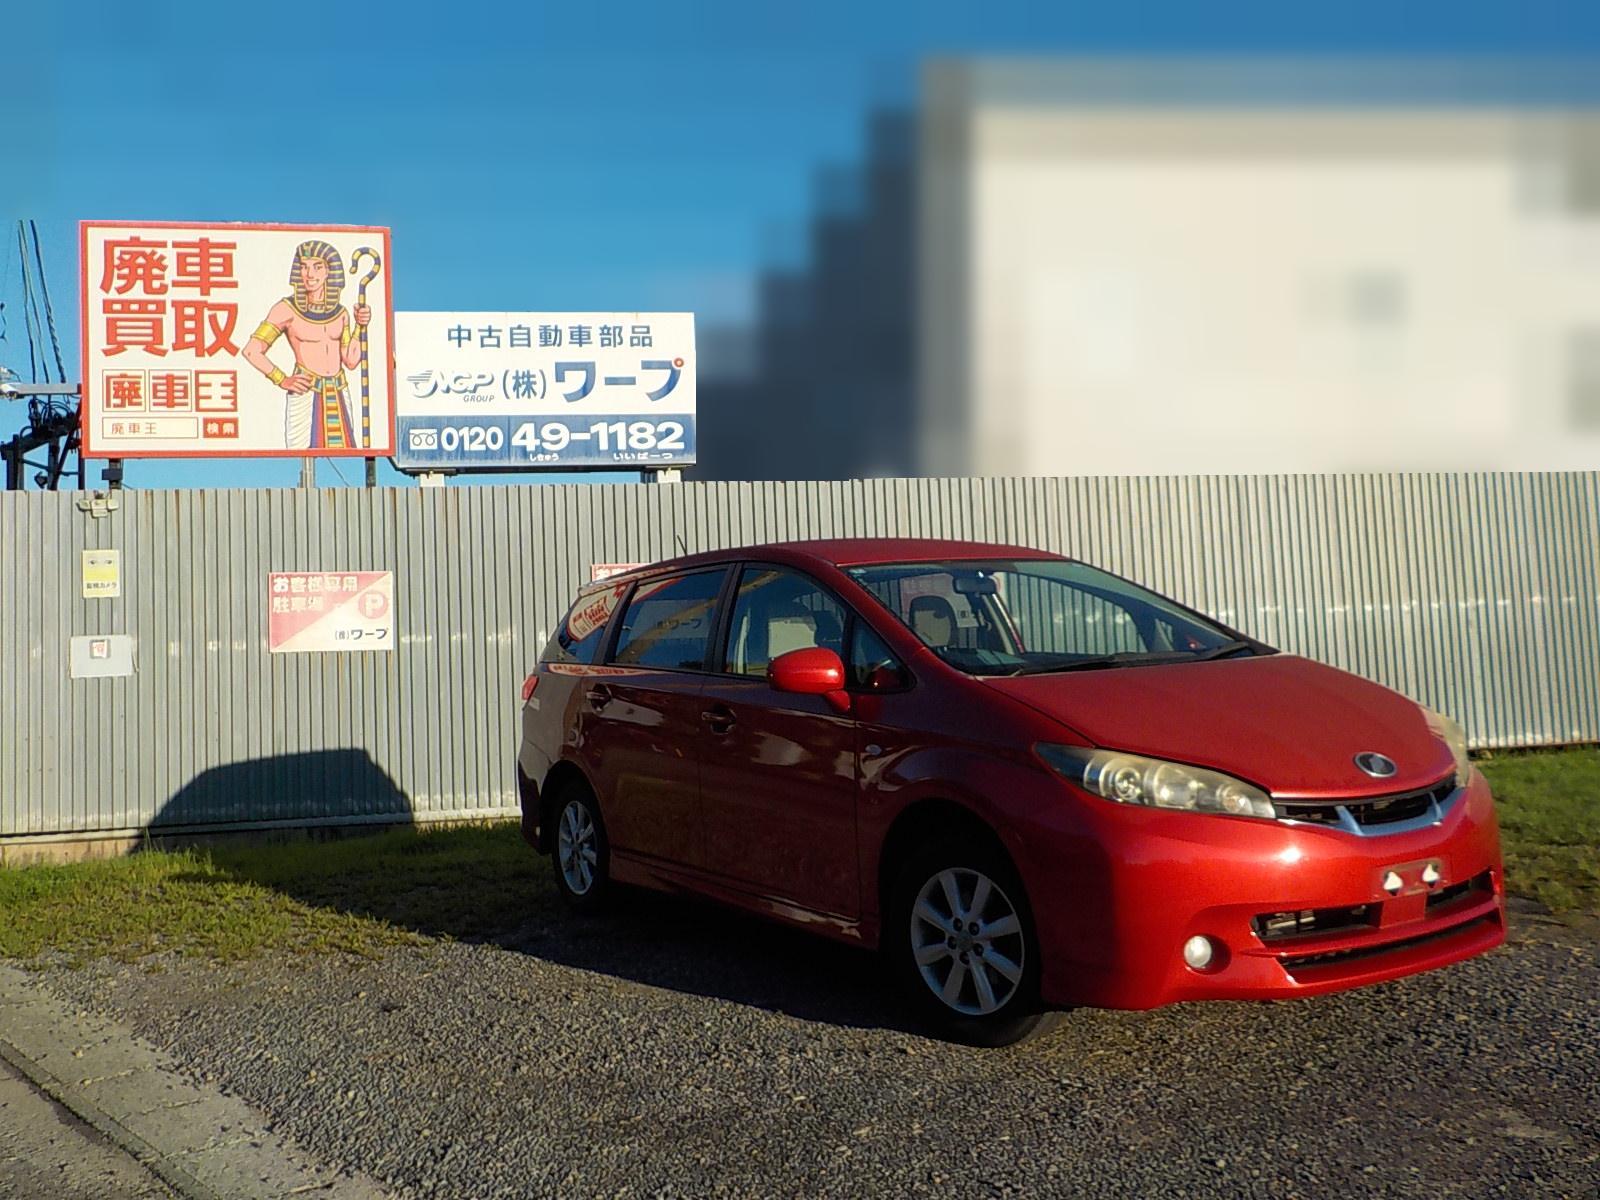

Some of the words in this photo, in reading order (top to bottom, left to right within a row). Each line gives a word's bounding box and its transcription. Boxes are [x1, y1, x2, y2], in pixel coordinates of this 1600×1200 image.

[100, 236, 239, 296] 廃車
[101, 299, 240, 358] 買取
[447, 324, 653, 349] 中古自動車部品
[463, 394, 495, 403] GROUP
[441, 426, 503, 451] 0120
[512, 421, 685, 451] 49-1182
